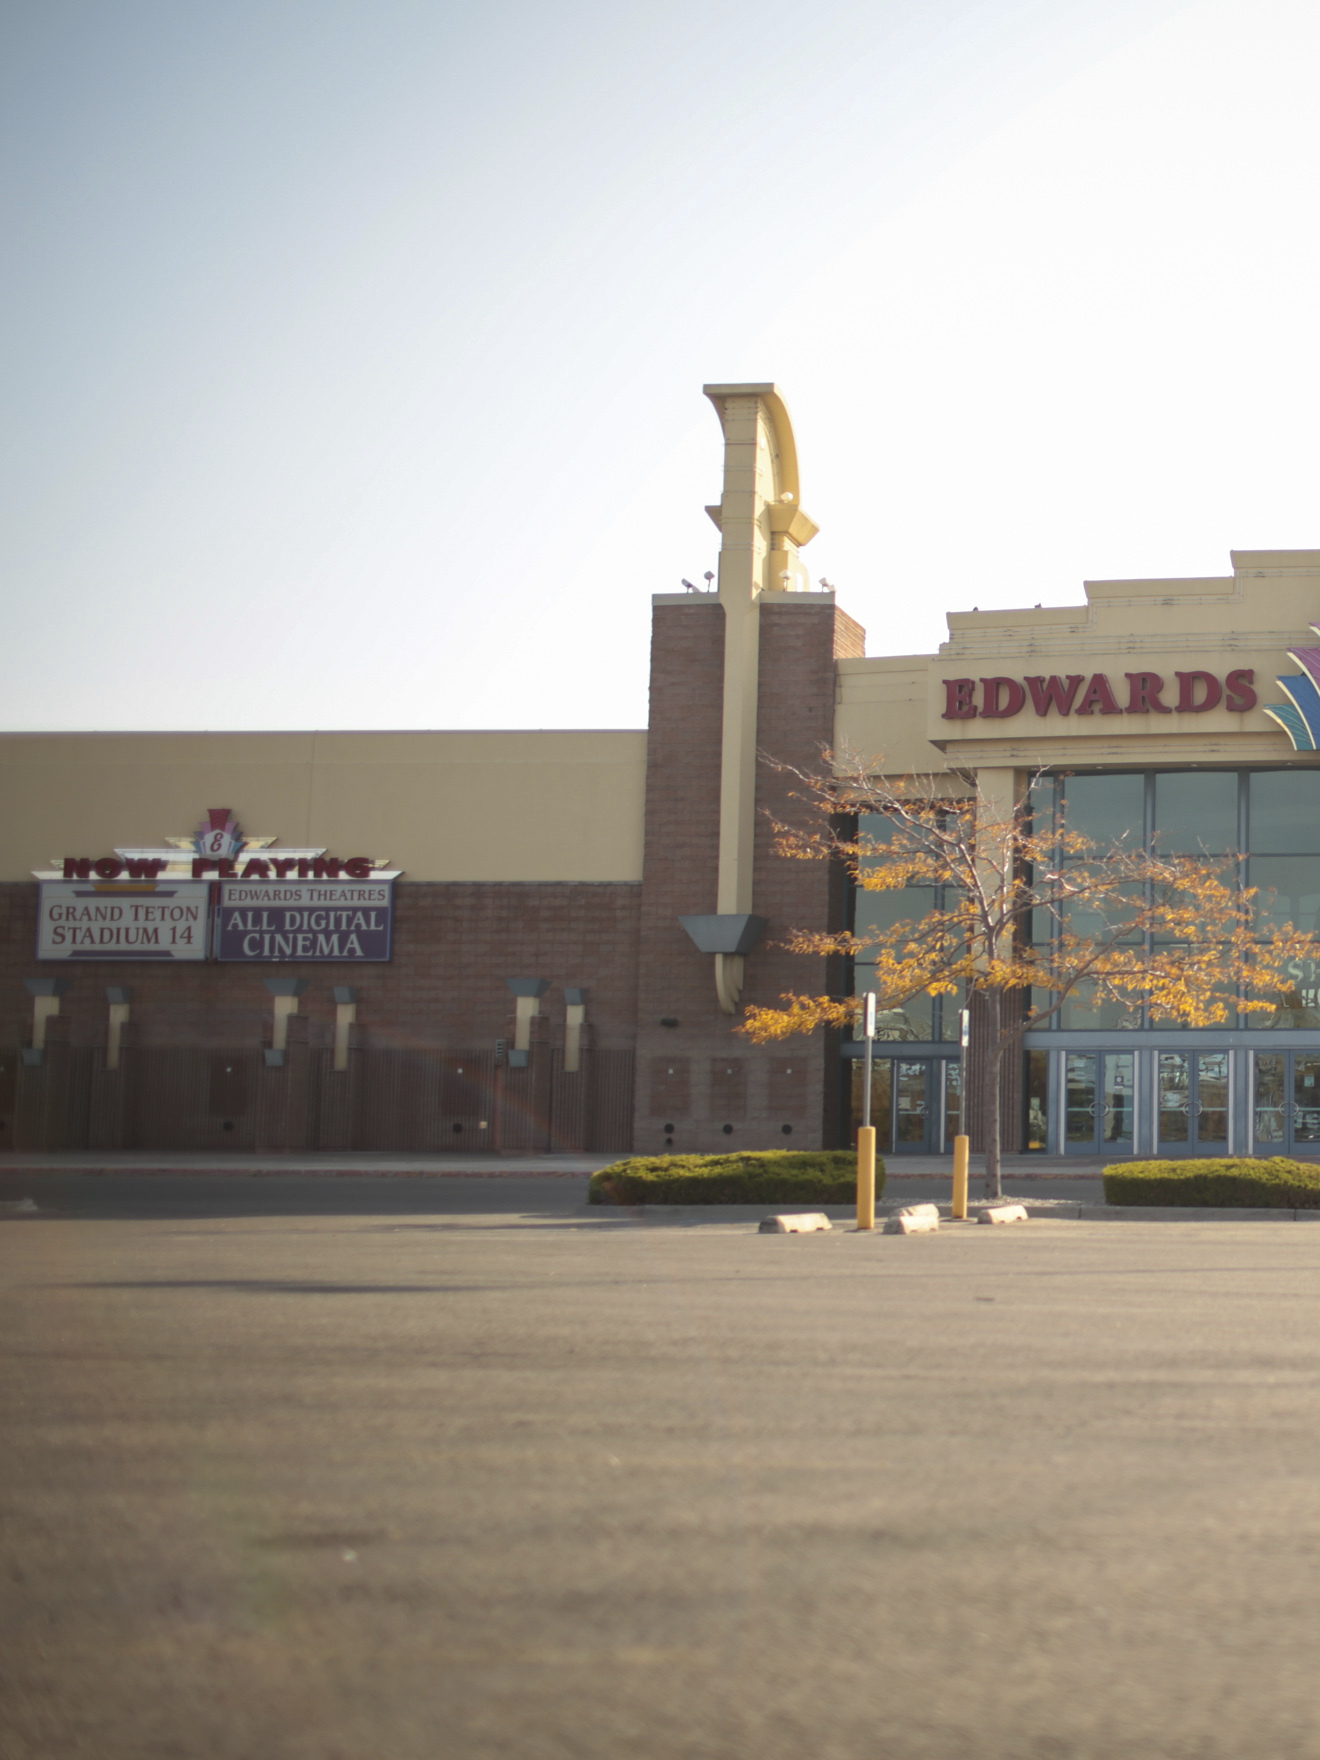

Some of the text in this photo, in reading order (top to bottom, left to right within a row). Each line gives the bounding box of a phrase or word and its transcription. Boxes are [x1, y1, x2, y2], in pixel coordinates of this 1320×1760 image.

[941, 669, 1257, 719] EDWARDS
[63, 857, 374, 879] NOW PLAYING
[228, 888, 386, 901] EDWARDS THEATRES
[49, 904, 199, 922] GRAND TETON
[226, 911, 384, 931] ALL DIGITAL
[52, 925, 194, 945] STADIUM 14
[243, 932, 365, 957] CINEMA
